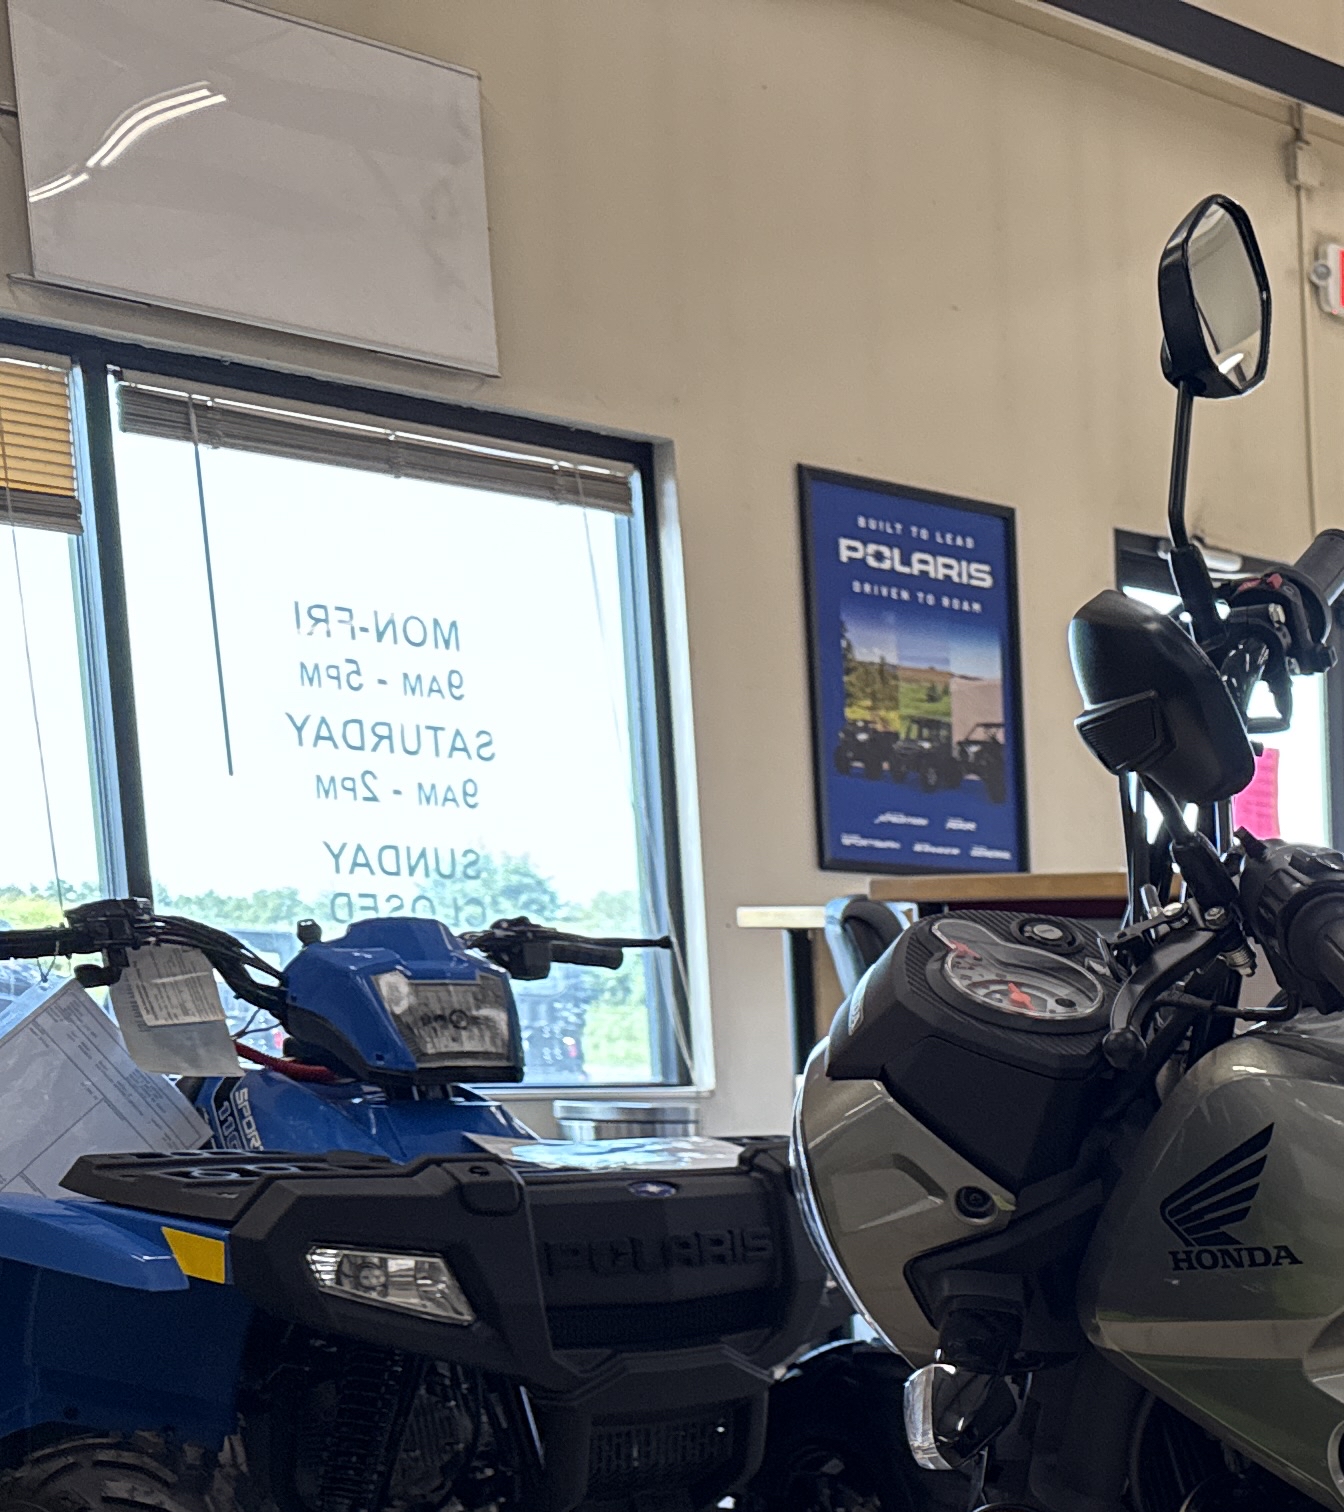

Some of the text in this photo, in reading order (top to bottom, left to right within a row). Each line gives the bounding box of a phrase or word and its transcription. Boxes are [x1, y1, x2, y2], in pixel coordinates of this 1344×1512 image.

[857, 515, 976, 549] BUILT TO LEAD
[838, 537, 994, 588] POLARIS
[852, 580, 983, 614] DRIVEN TO ROAM
[235, 1088, 264, 1152] SPOR
[544, 1229, 774, 1276] POLARIS
[1168, 1245, 1303, 1271] HONDA
